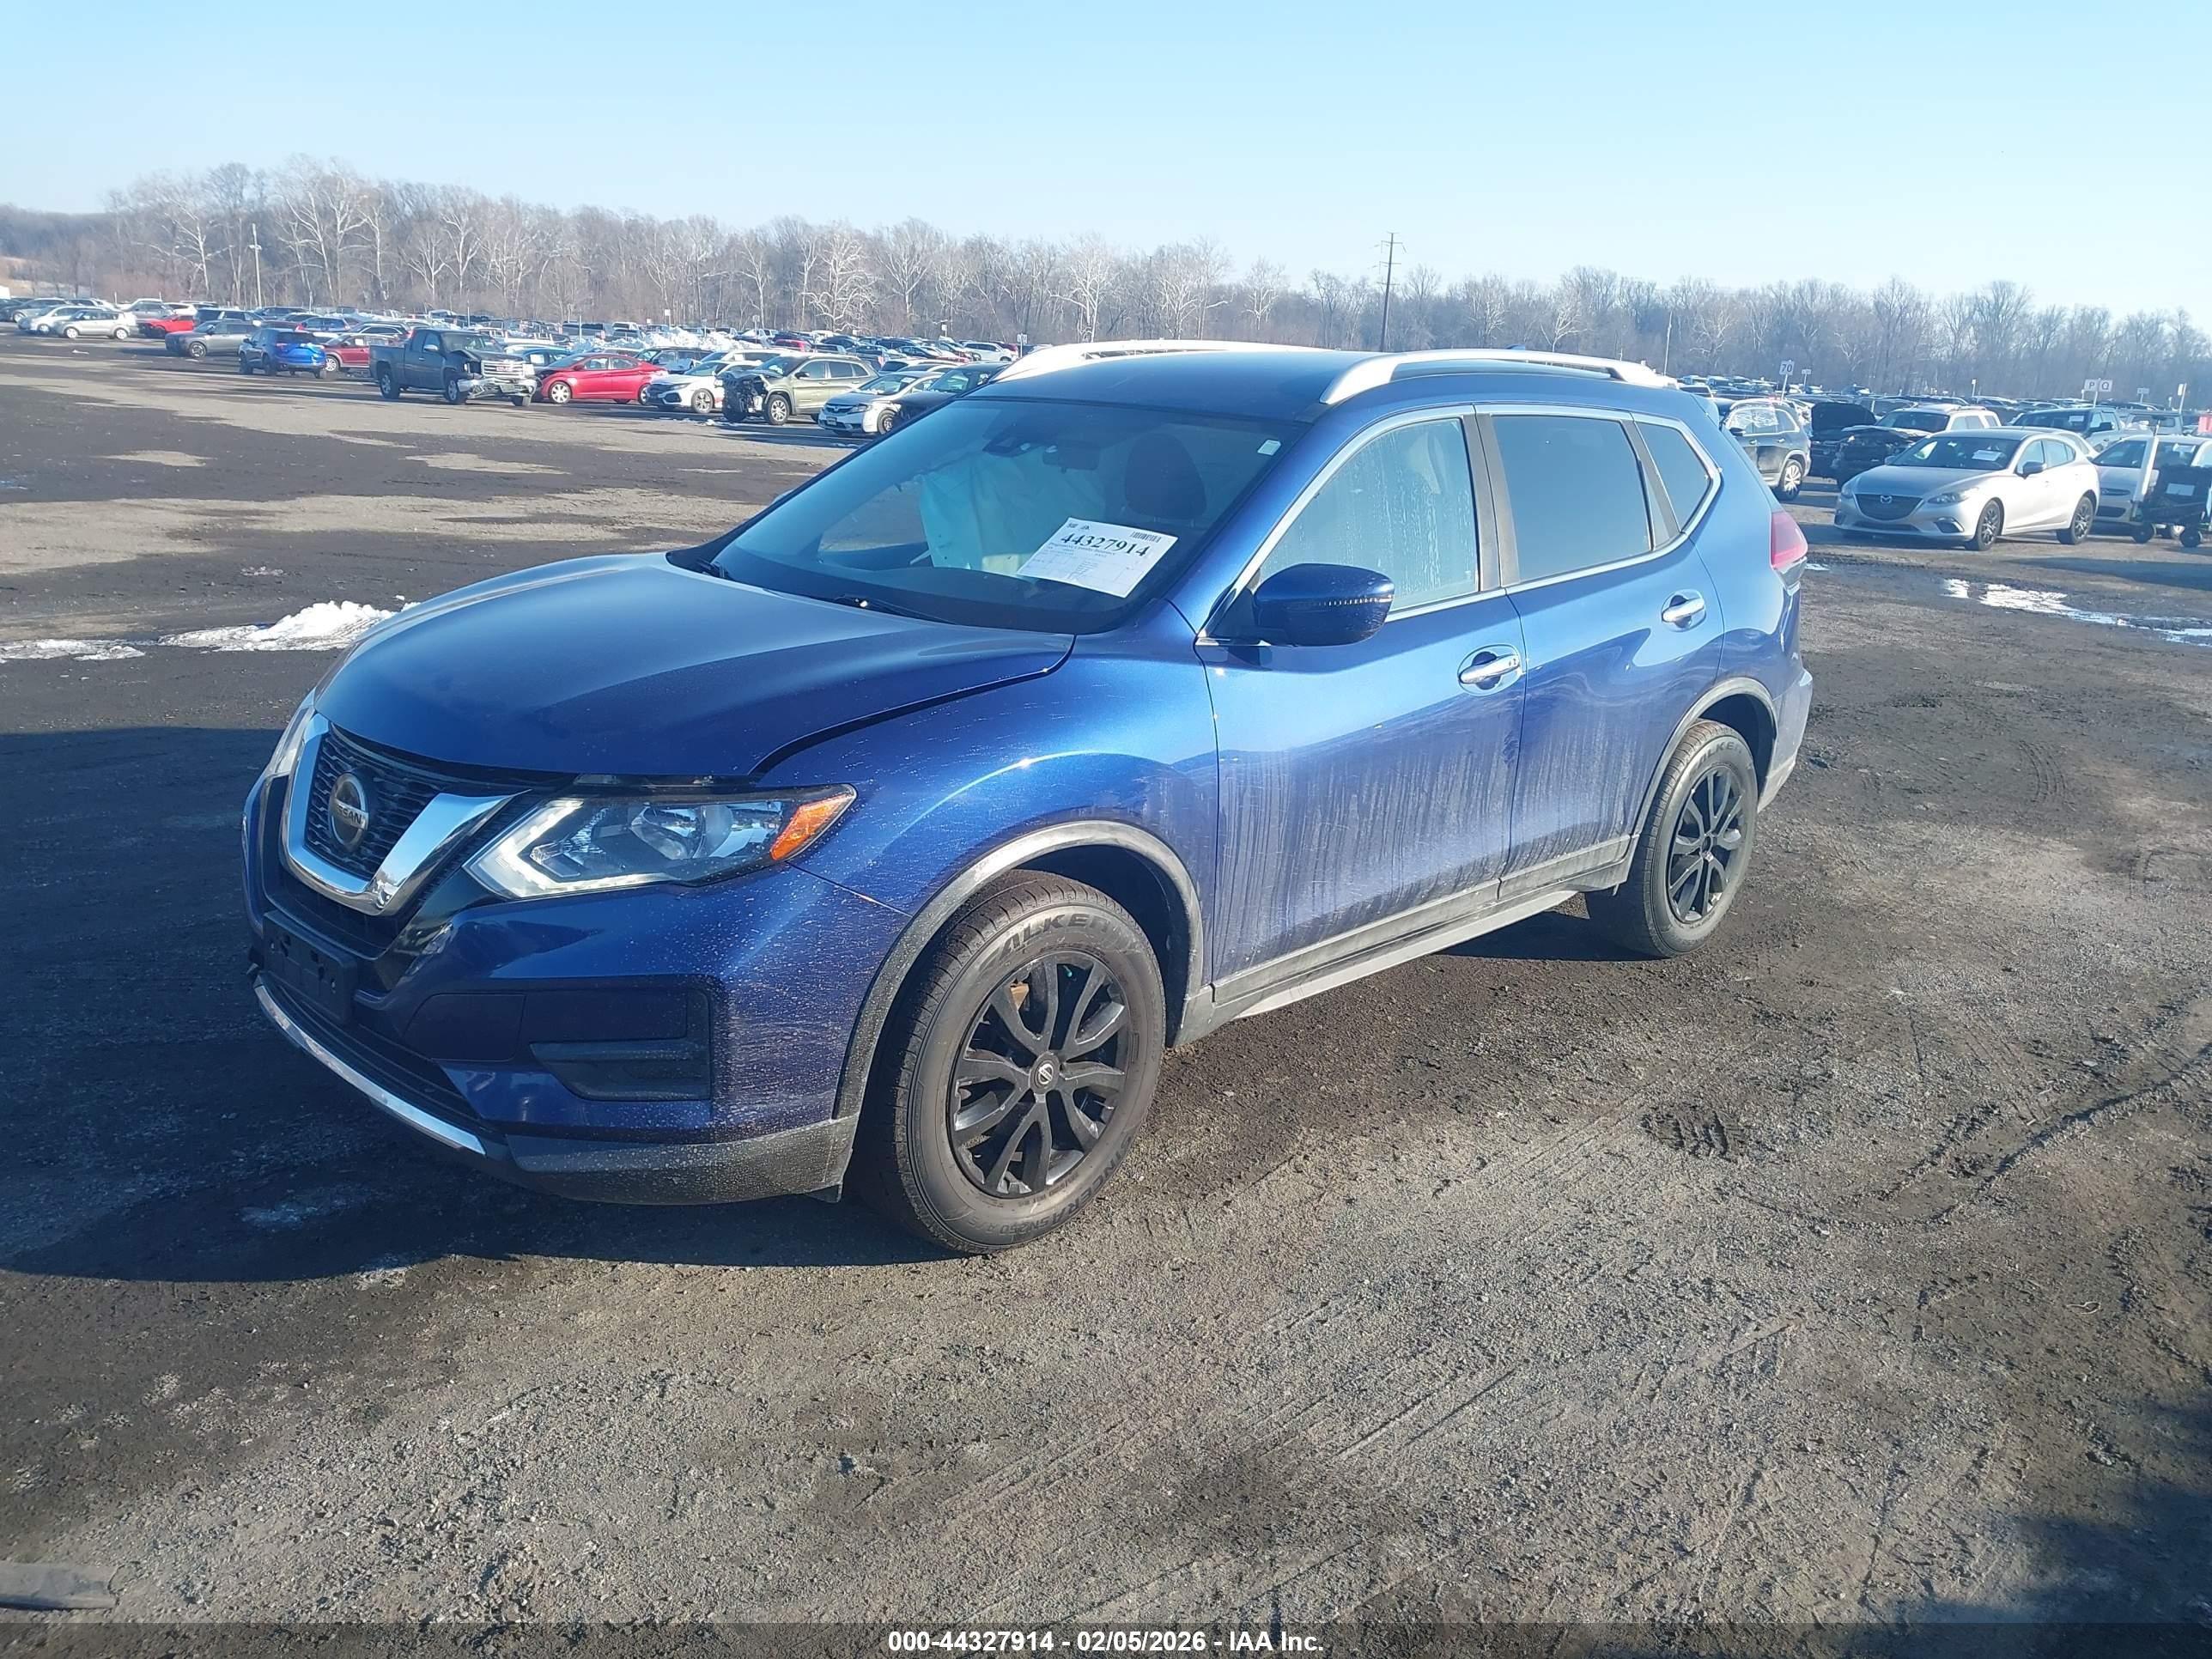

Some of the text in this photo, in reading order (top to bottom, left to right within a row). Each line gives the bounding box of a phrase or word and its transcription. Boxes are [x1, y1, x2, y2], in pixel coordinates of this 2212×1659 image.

[1780, 363, 1793, 373] 70
[2088, 381, 2095, 390] P
[2101, 381, 2110, 391] Q
[1060, 532, 1151, 557] 44327914
